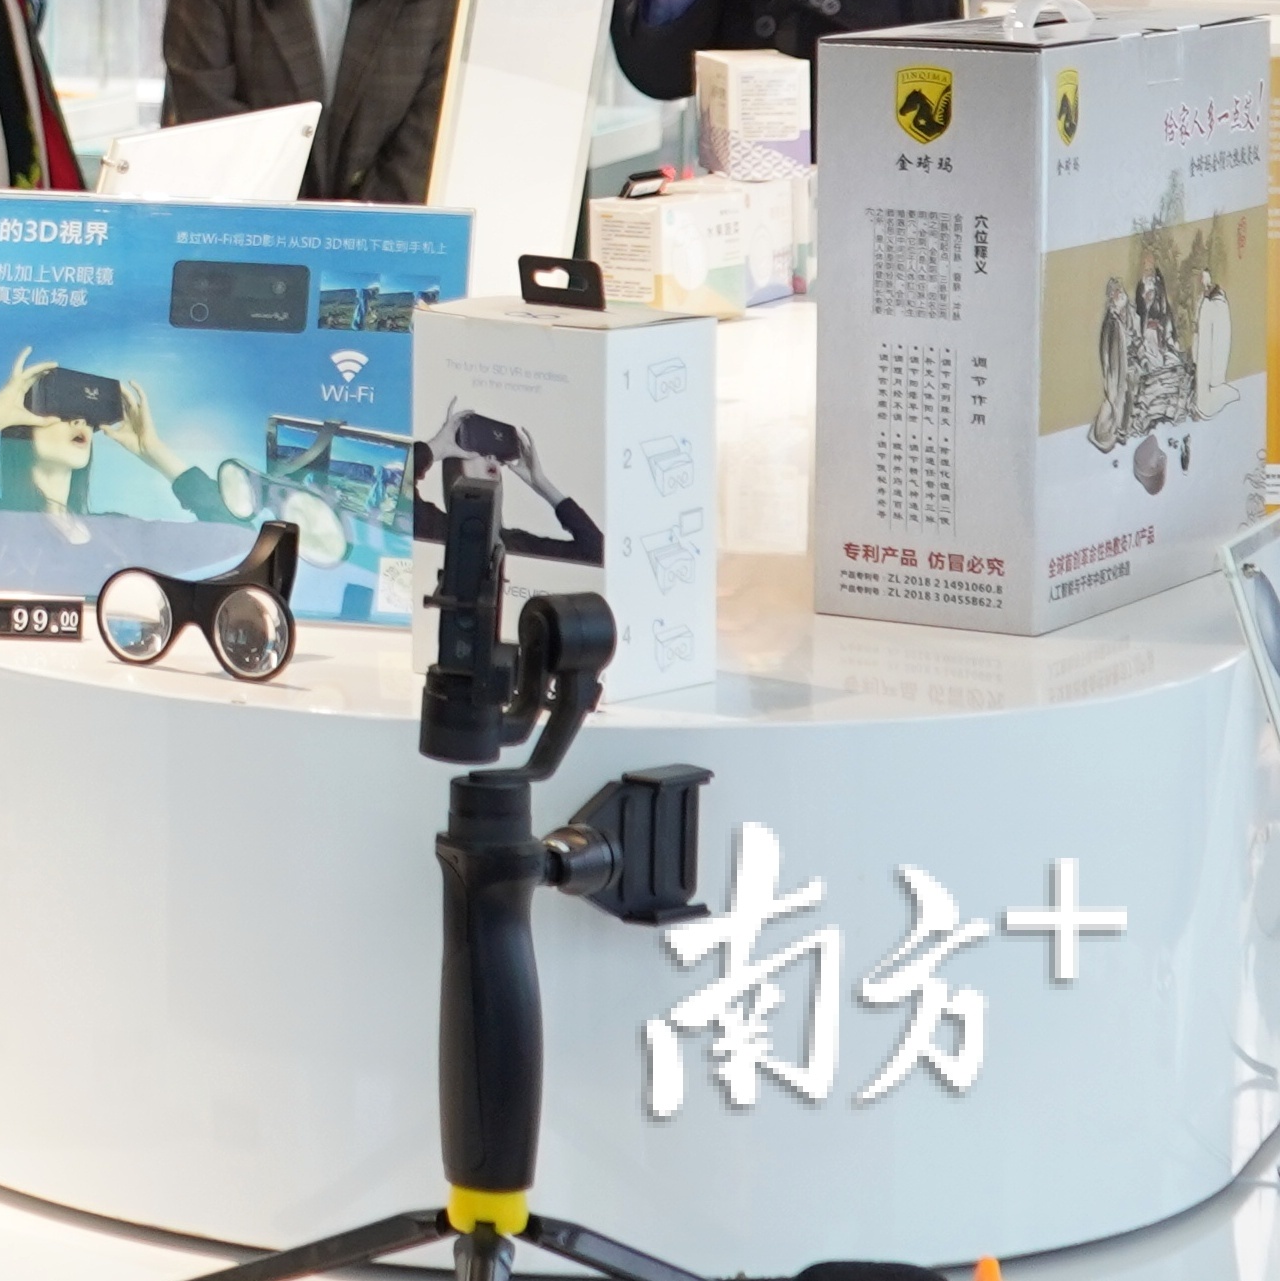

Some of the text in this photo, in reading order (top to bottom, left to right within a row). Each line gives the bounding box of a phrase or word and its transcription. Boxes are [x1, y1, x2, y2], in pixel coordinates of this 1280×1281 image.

[321, 383, 375, 405] Wi-Fi
[622, 449, 632, 469] 2
[622, 537, 632, 558] 3
[843, 542, 1006, 577] 专利产品 仿冒必究
[904, 575, 931, 588] 2018
[904, 589, 931, 602] 2018
[621, 625, 632, 645] 4
